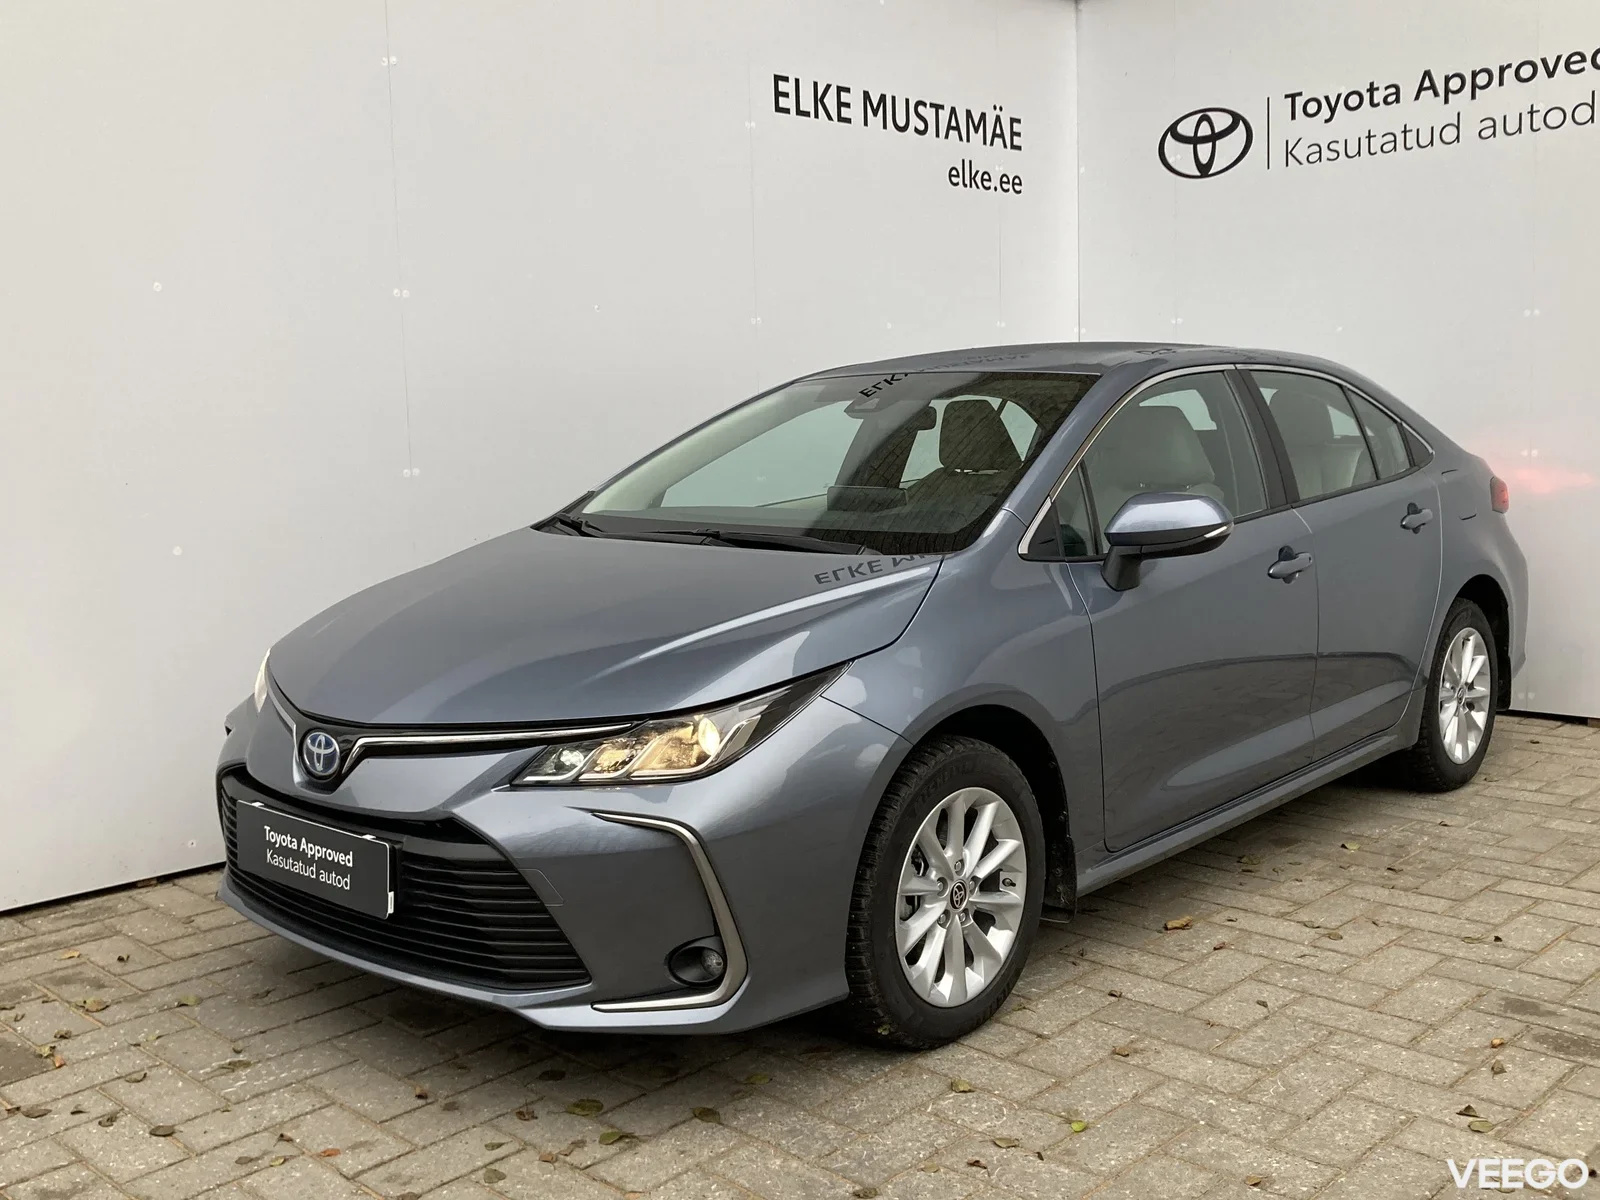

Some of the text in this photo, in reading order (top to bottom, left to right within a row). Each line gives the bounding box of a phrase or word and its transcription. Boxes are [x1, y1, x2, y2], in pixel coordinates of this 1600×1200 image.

[773, 73, 1023, 152] ELKE MUSTAMÄE
[1284, 80, 1401, 124] Toyota
[1285, 89, 1596, 168] Kasutatud autod
[948, 158, 1023, 195] elke.ee
[264, 825, 353, 868] Toyota Approved
[266, 848, 351, 891] Kasutatud autod
